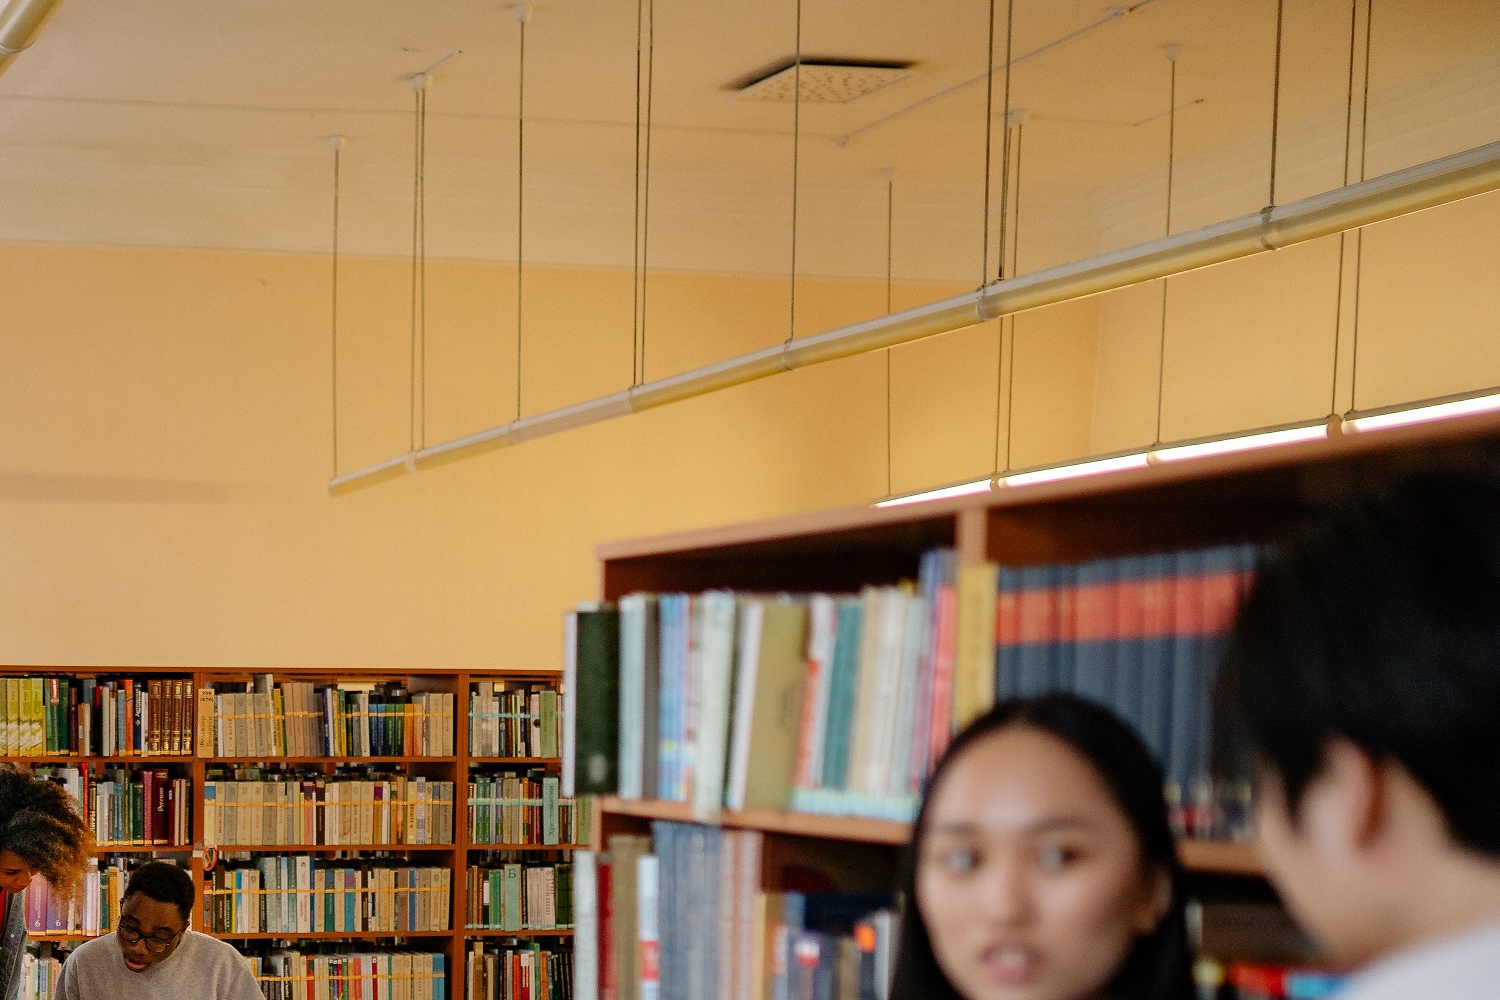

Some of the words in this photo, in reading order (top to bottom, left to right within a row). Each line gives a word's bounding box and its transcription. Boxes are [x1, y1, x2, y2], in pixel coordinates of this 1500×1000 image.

[508, 868, 517, 879] Б
[35, 919, 41, 928] 6
[55, 919, 61, 927] 6
